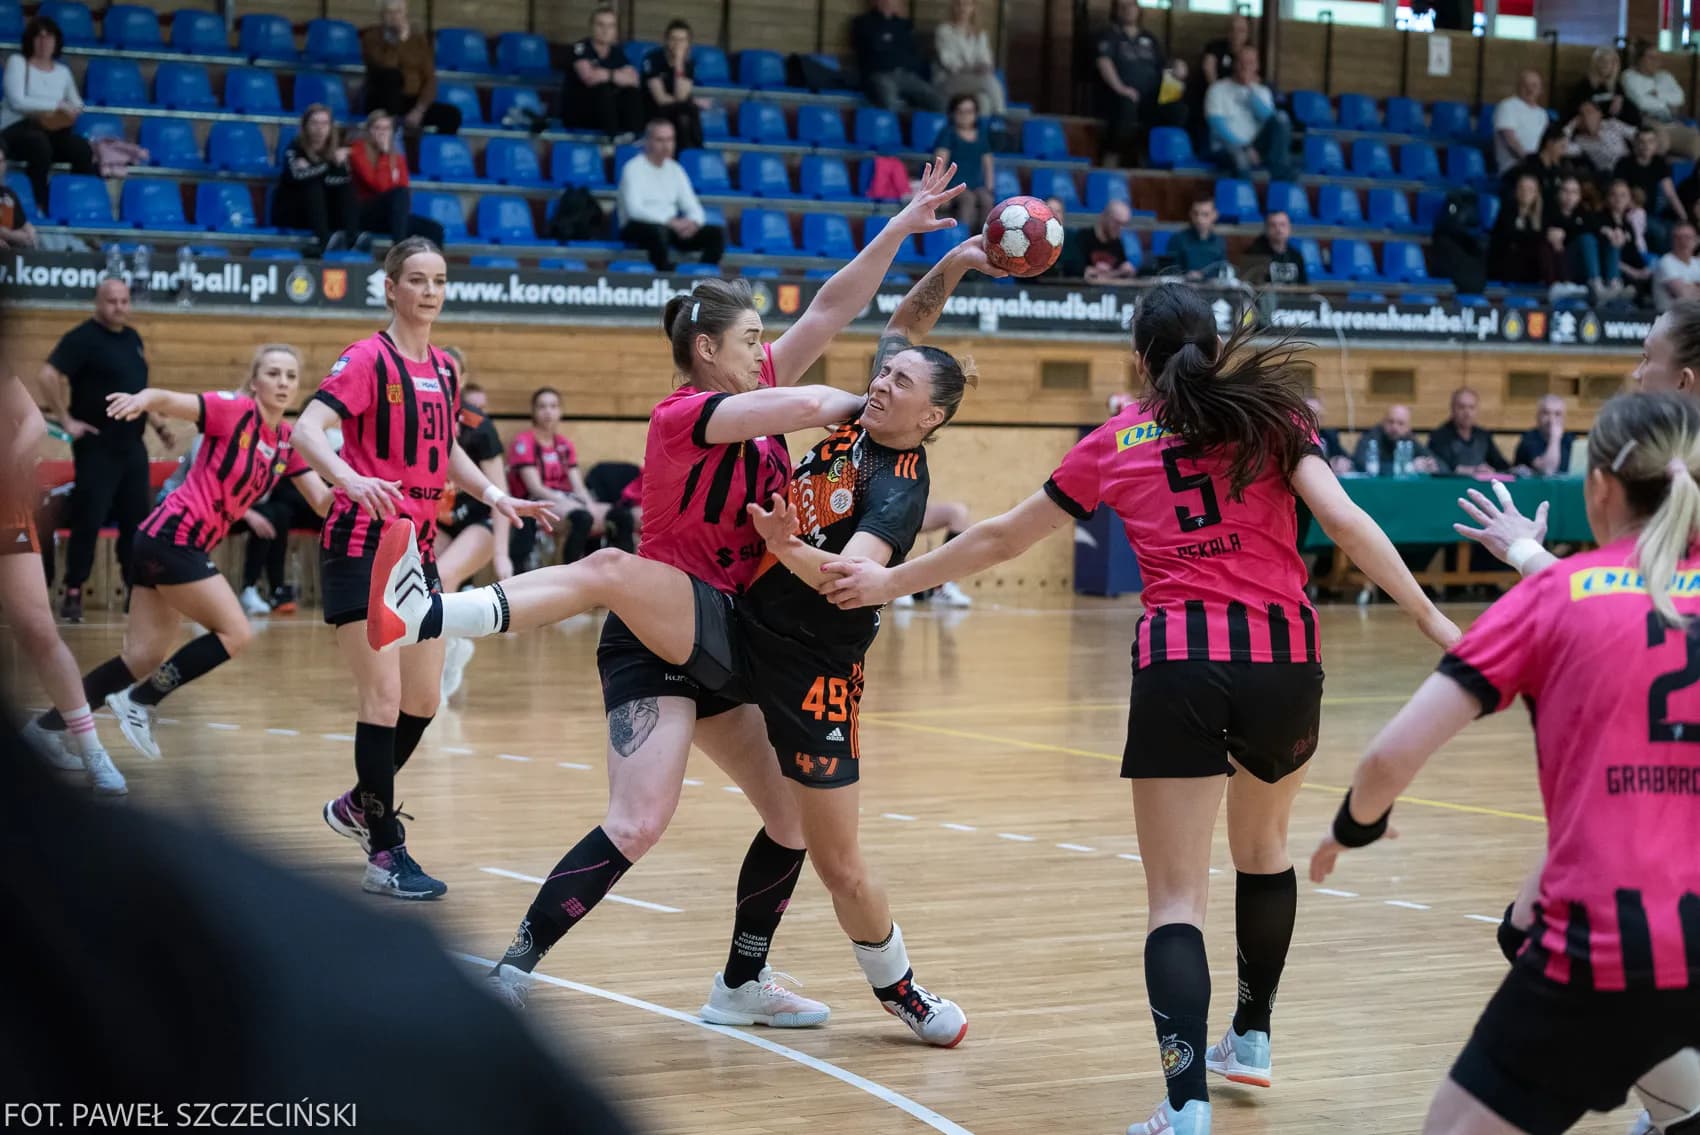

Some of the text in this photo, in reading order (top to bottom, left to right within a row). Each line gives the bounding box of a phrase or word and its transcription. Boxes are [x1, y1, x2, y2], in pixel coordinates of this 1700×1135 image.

[422, 402, 444, 440] 31
[1162, 445, 1222, 532] 5
[801, 675, 848, 722] 49
